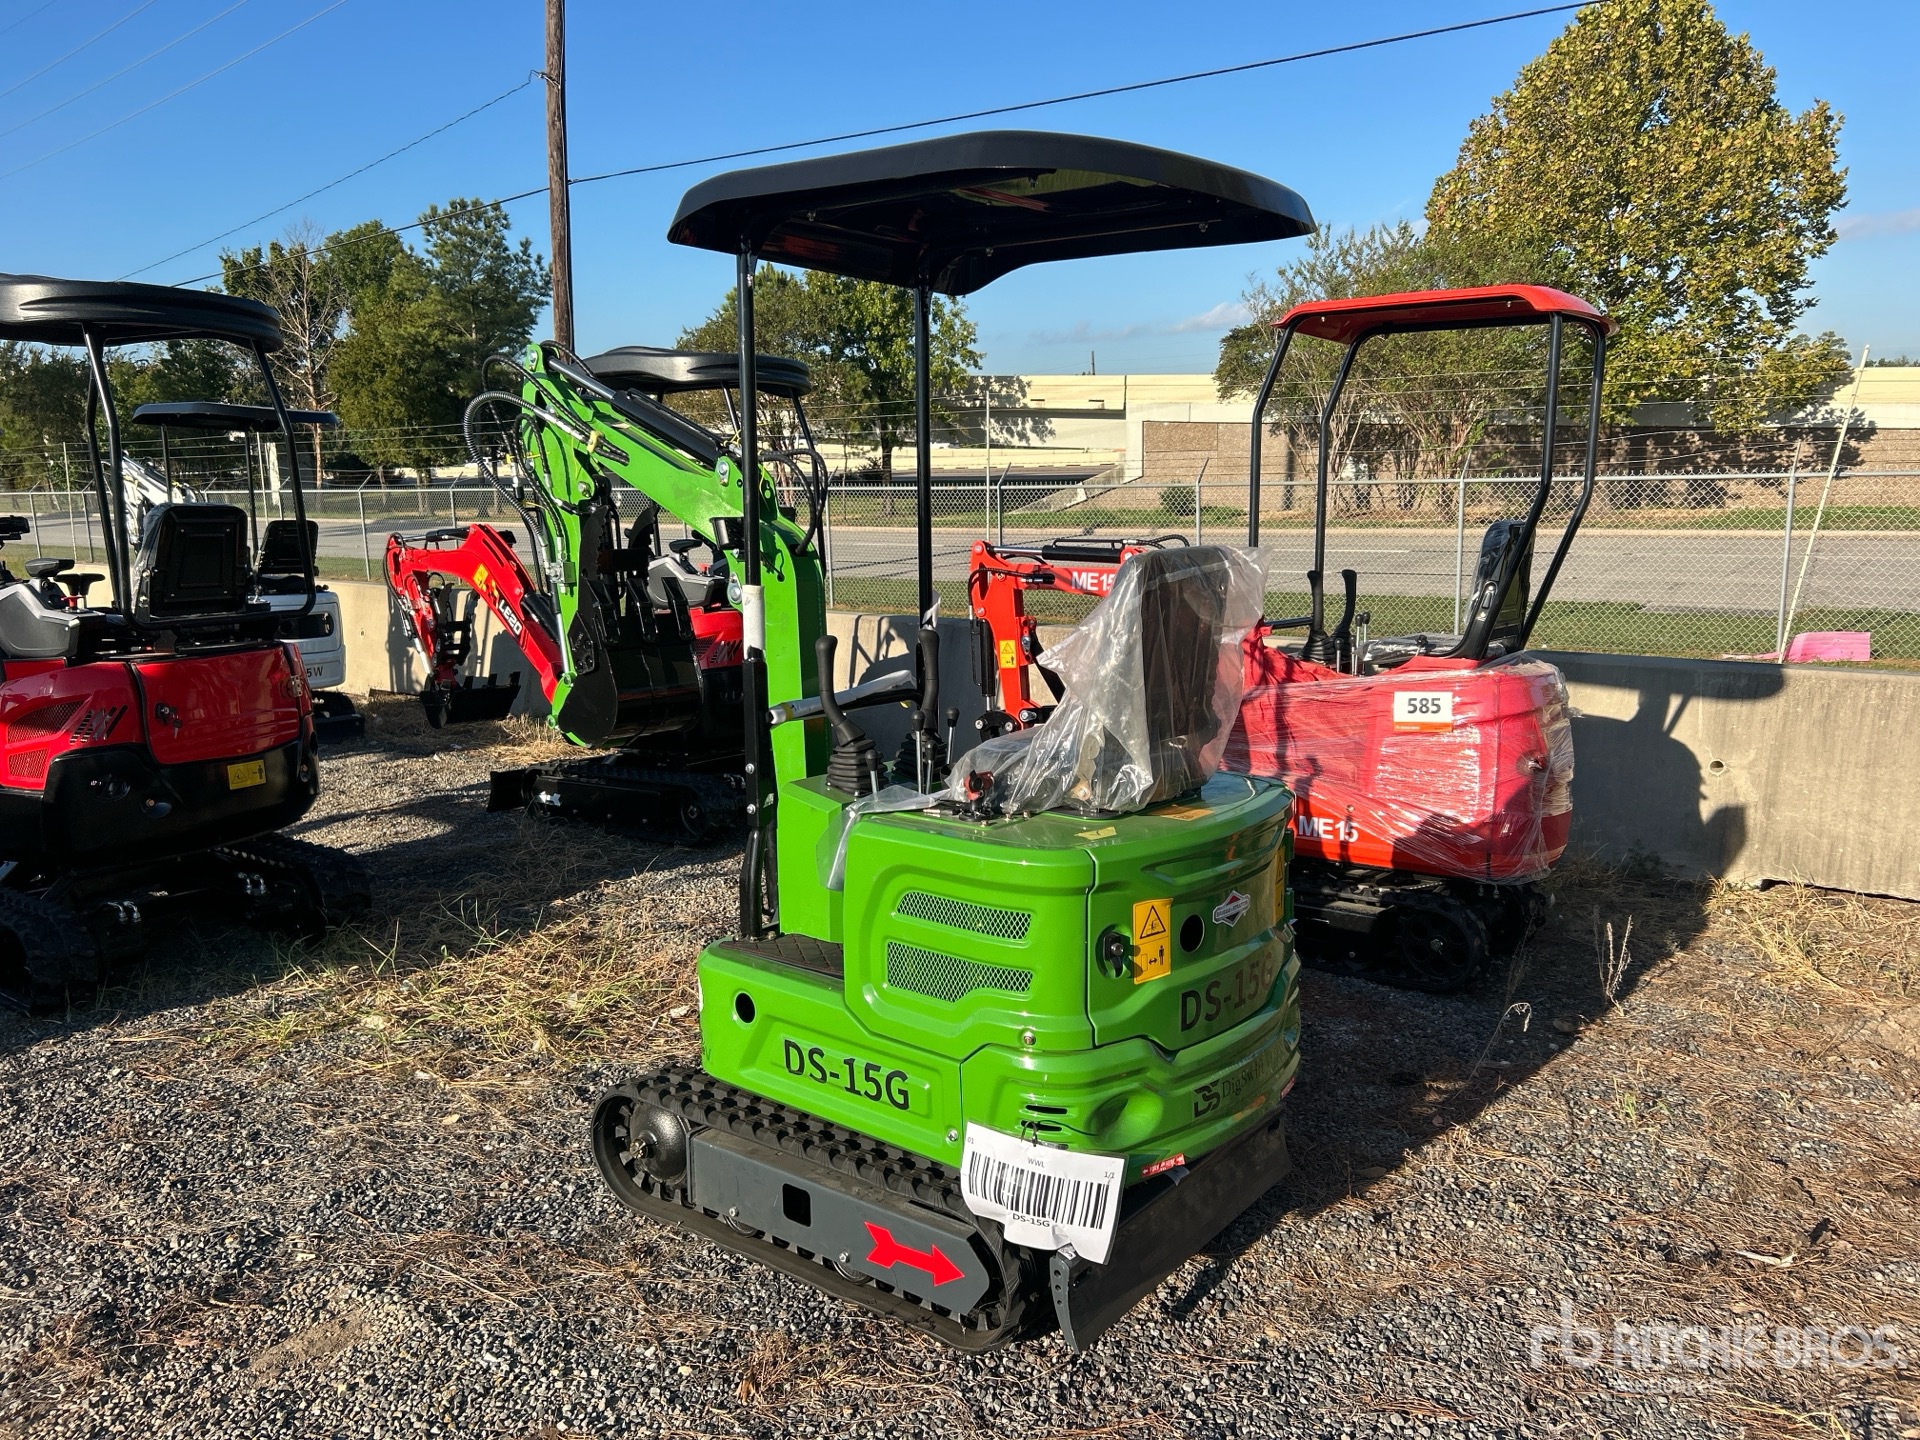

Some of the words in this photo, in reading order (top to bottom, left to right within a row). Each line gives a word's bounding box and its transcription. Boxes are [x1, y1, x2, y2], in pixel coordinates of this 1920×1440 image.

[498, 599, 523, 635] LE20
[1407, 697, 1442, 714] 585
[1298, 815, 1359, 843] ME15
[1180, 951, 1273, 1033] DS-15G
[784, 1039, 910, 1111] DS-15G
[1027, 1157, 1045, 1168] WWL
[1012, 1213, 1050, 1228] DS-15G
